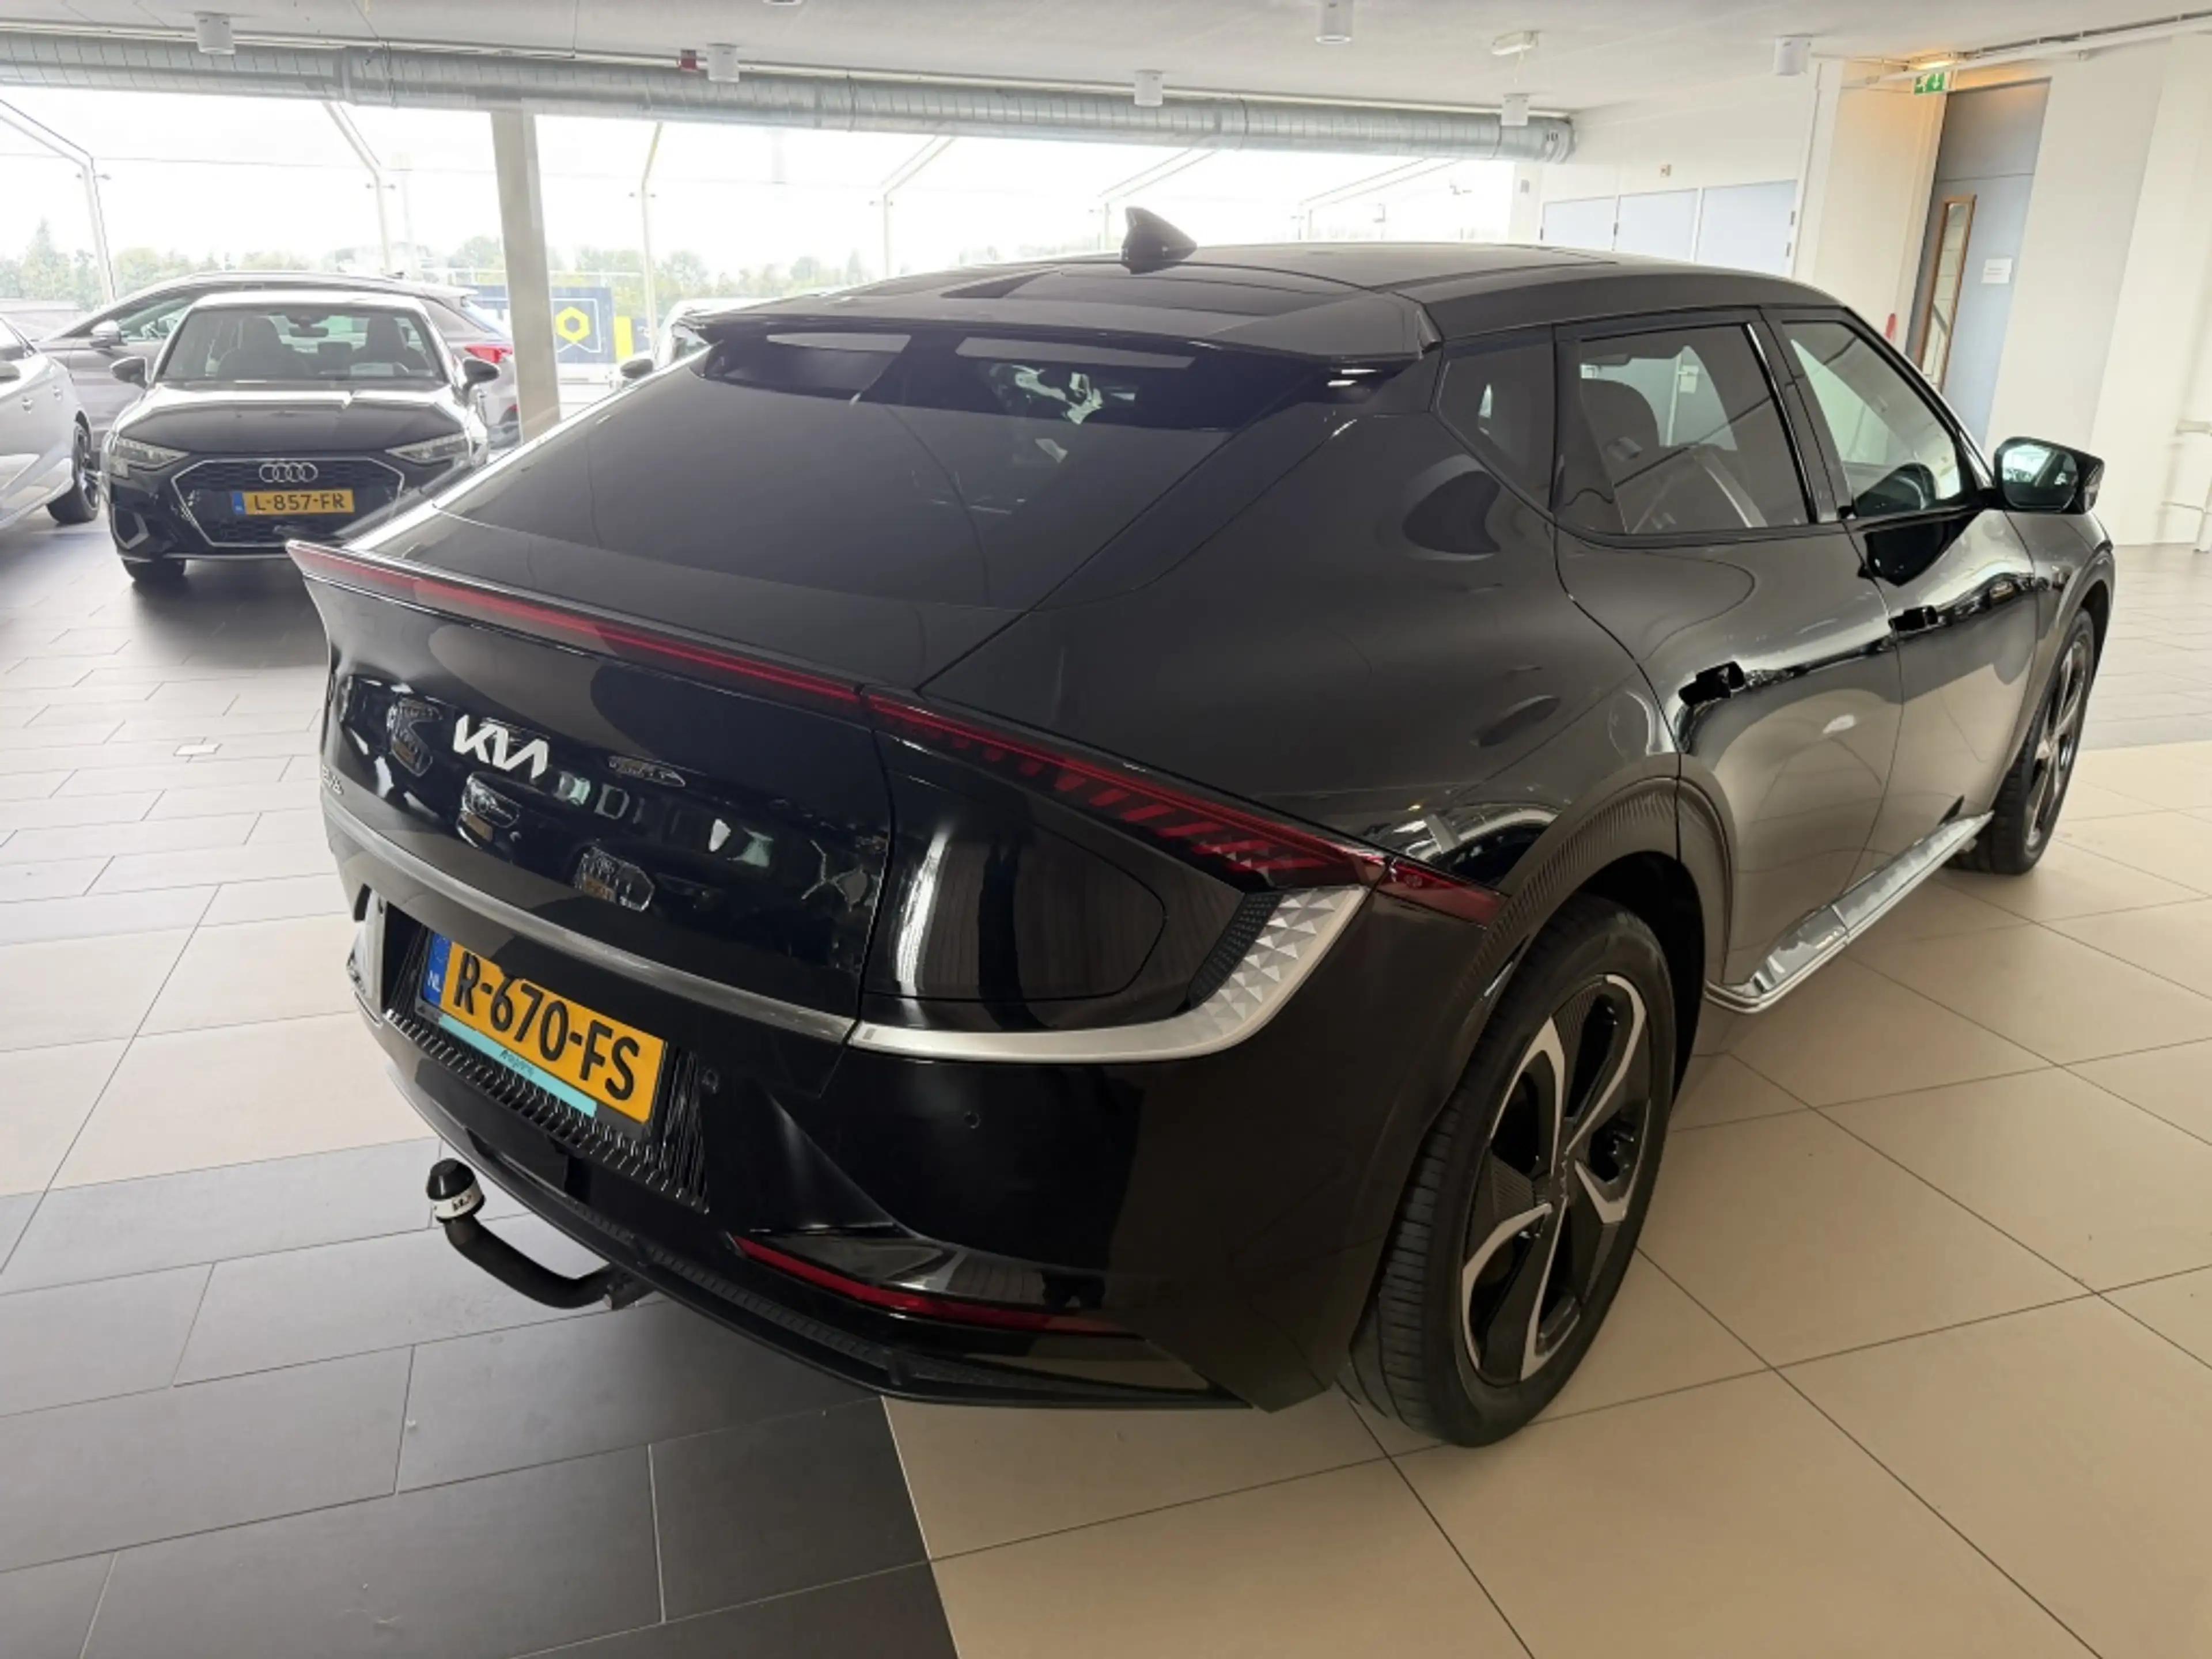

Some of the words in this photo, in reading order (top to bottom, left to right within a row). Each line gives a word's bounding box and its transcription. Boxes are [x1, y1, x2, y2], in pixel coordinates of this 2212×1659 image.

[253, 492, 345, 512] L-857-FR
[453, 714, 549, 779] KIA
[427, 969, 441, 992] NL
[453, 950, 640, 1101] R-670-FS
